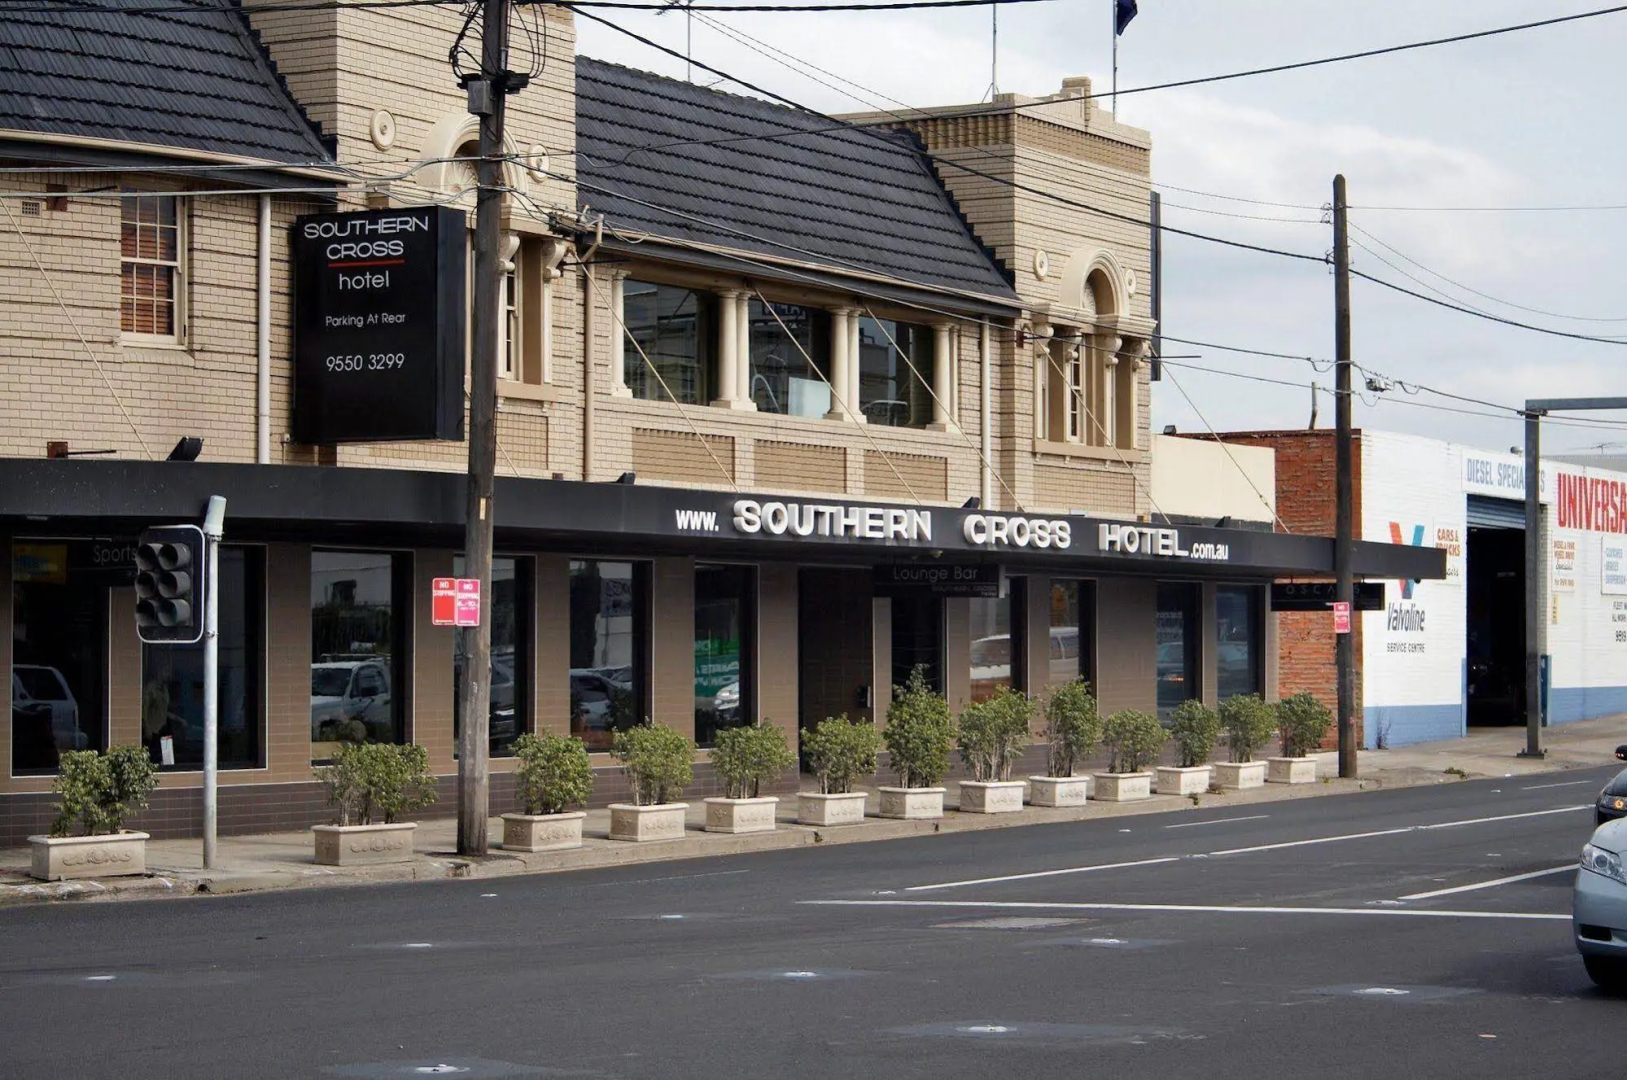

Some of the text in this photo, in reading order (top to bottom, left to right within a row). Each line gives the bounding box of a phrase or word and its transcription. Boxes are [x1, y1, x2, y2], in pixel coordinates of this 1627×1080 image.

[304, 216, 429, 239] SOUTHERN
[326, 240, 404, 260] CROSS
[339, 270, 389, 290] hotel
[325, 312, 405, 328] Parking At Rear
[326, 353, 405, 372] 9550 3299
[1467, 458, 1494, 485] DIESEL
[1558, 472, 1627, 535] UNIVERSA
[675, 509, 719, 532] www.
[733, 500, 932, 541] SOUTHERN
[963, 513, 1071, 549] CROSS
[93, 544, 138, 565] Sports
[893, 566, 978, 583] Lounge Bar
[1285, 584, 1360, 595] OSCAS
[1387, 602, 1425, 631] Valvoline
